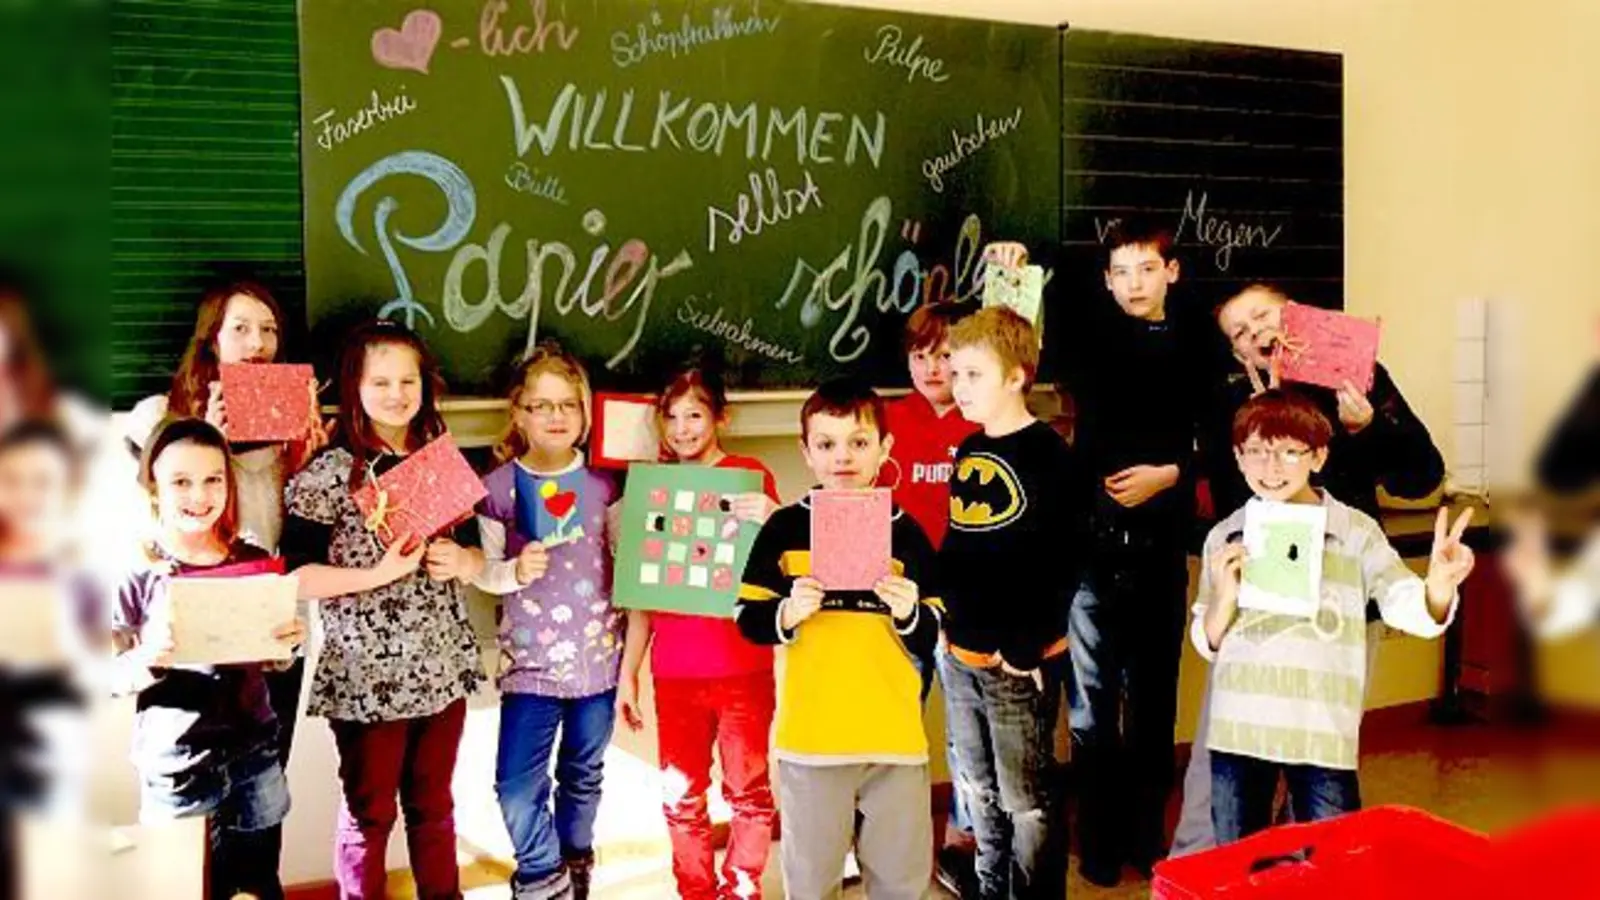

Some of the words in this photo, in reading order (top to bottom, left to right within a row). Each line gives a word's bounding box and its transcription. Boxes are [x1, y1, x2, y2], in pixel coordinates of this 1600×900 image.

[864, 24, 950, 82] Pulpe
[500, 75, 885, 168] WILLKOMMEN
[335, 149, 692, 369] Papier
[708, 168, 823, 252] selbst
[1173, 189, 1282, 271] Megen
[912, 462, 954, 483] PUM
